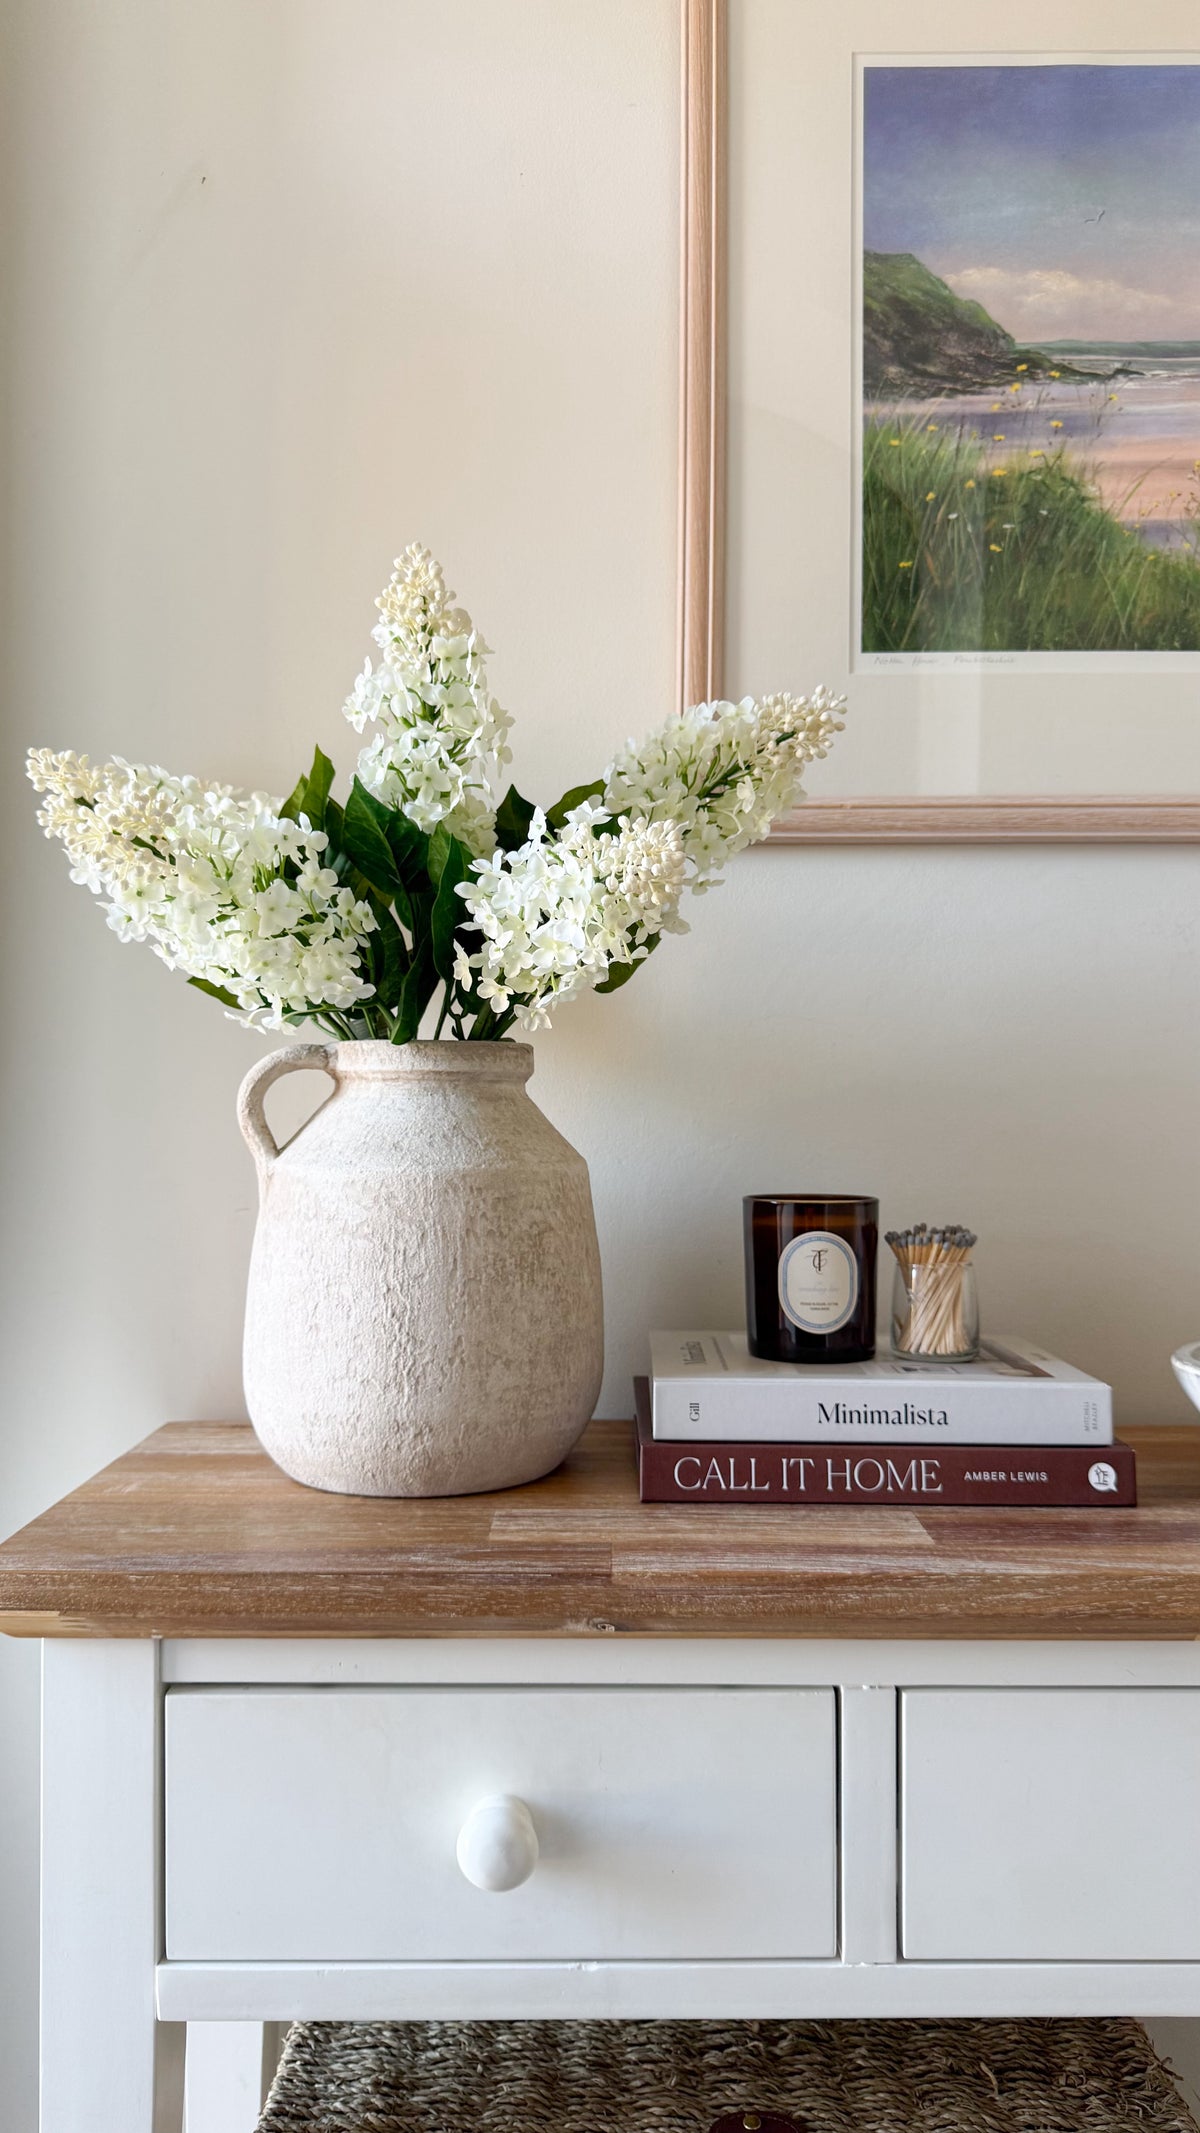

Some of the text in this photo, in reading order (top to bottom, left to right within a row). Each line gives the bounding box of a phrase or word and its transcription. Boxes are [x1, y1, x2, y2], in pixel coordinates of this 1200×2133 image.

[689, 1402, 700, 1422] Gill
[817, 1402, 949, 1426] Minimalista
[673, 1456, 1048, 1493] CALL IT HOME AMBER LEWIS
